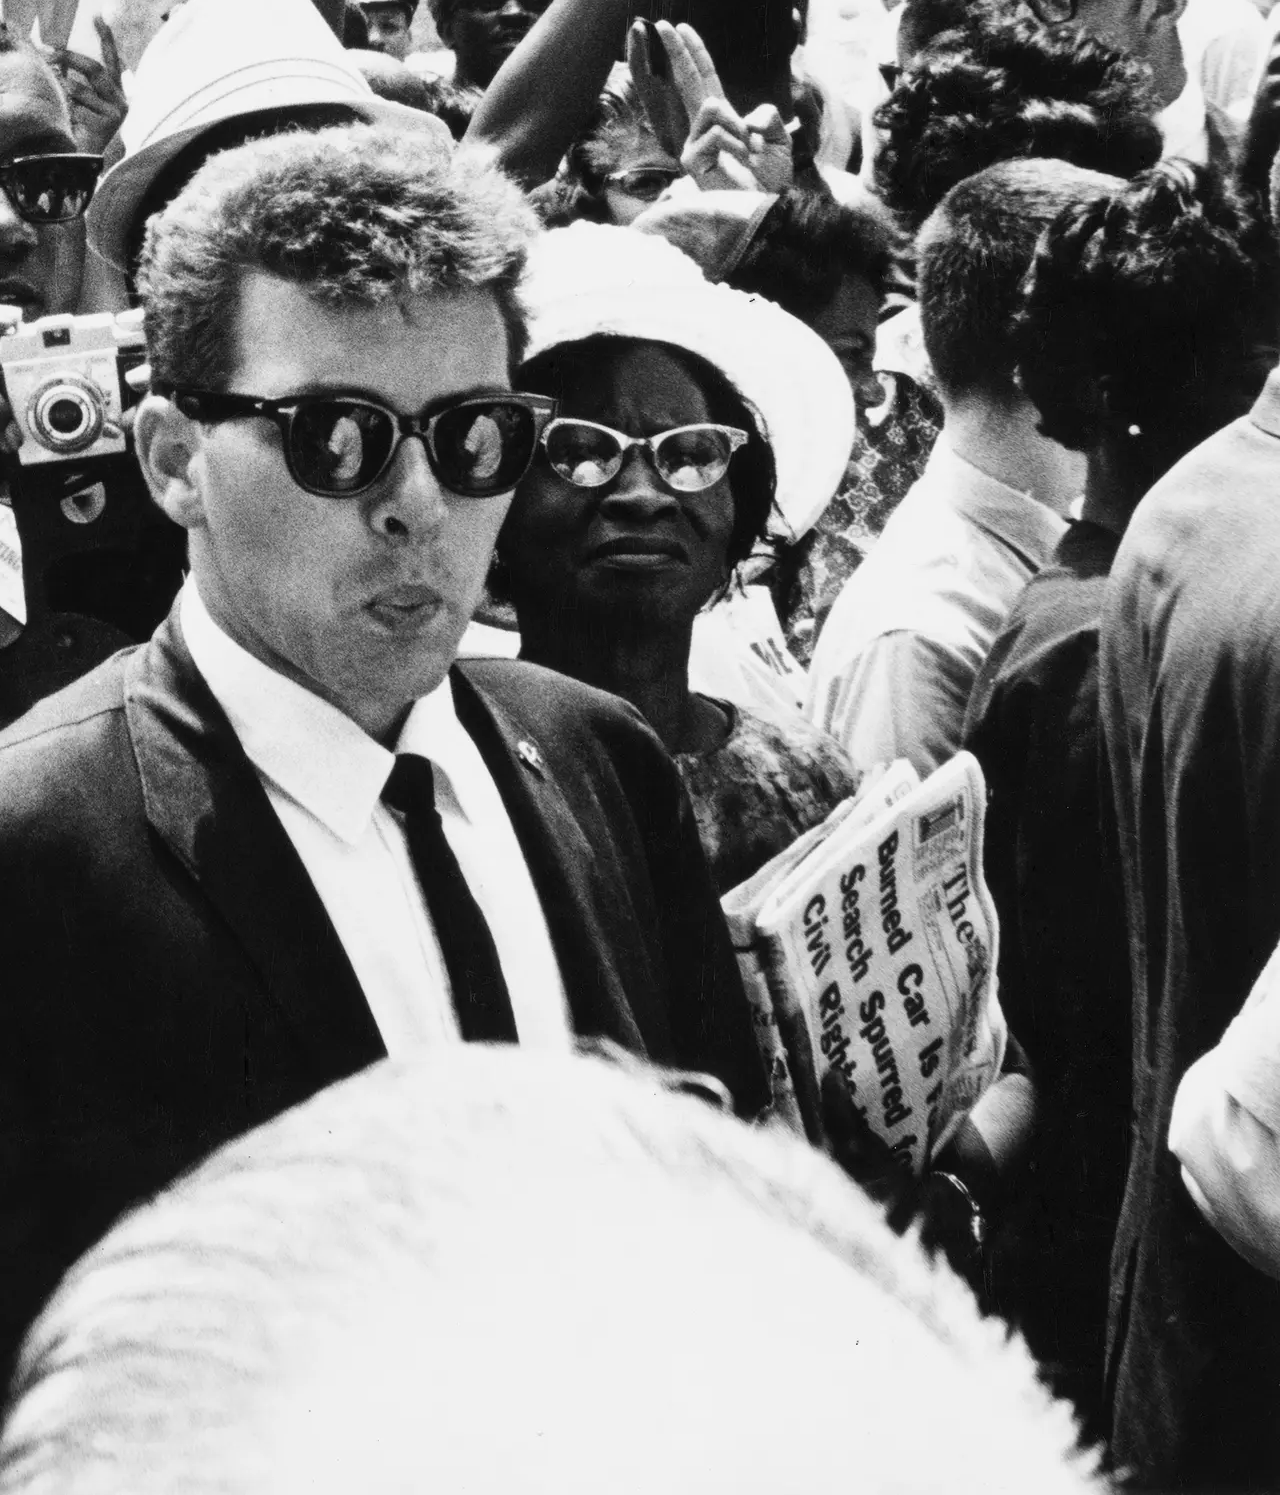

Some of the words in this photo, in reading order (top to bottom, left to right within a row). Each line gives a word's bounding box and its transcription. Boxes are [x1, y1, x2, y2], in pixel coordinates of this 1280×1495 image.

[802, 892, 832, 977] Civil
[877, 829, 913, 956] Burned
[897, 962, 931, 1028] Car
[942, 861, 975, 944] The
[840, 863, 874, 983] Search
[859, 989, 913, 1129] Spurred
